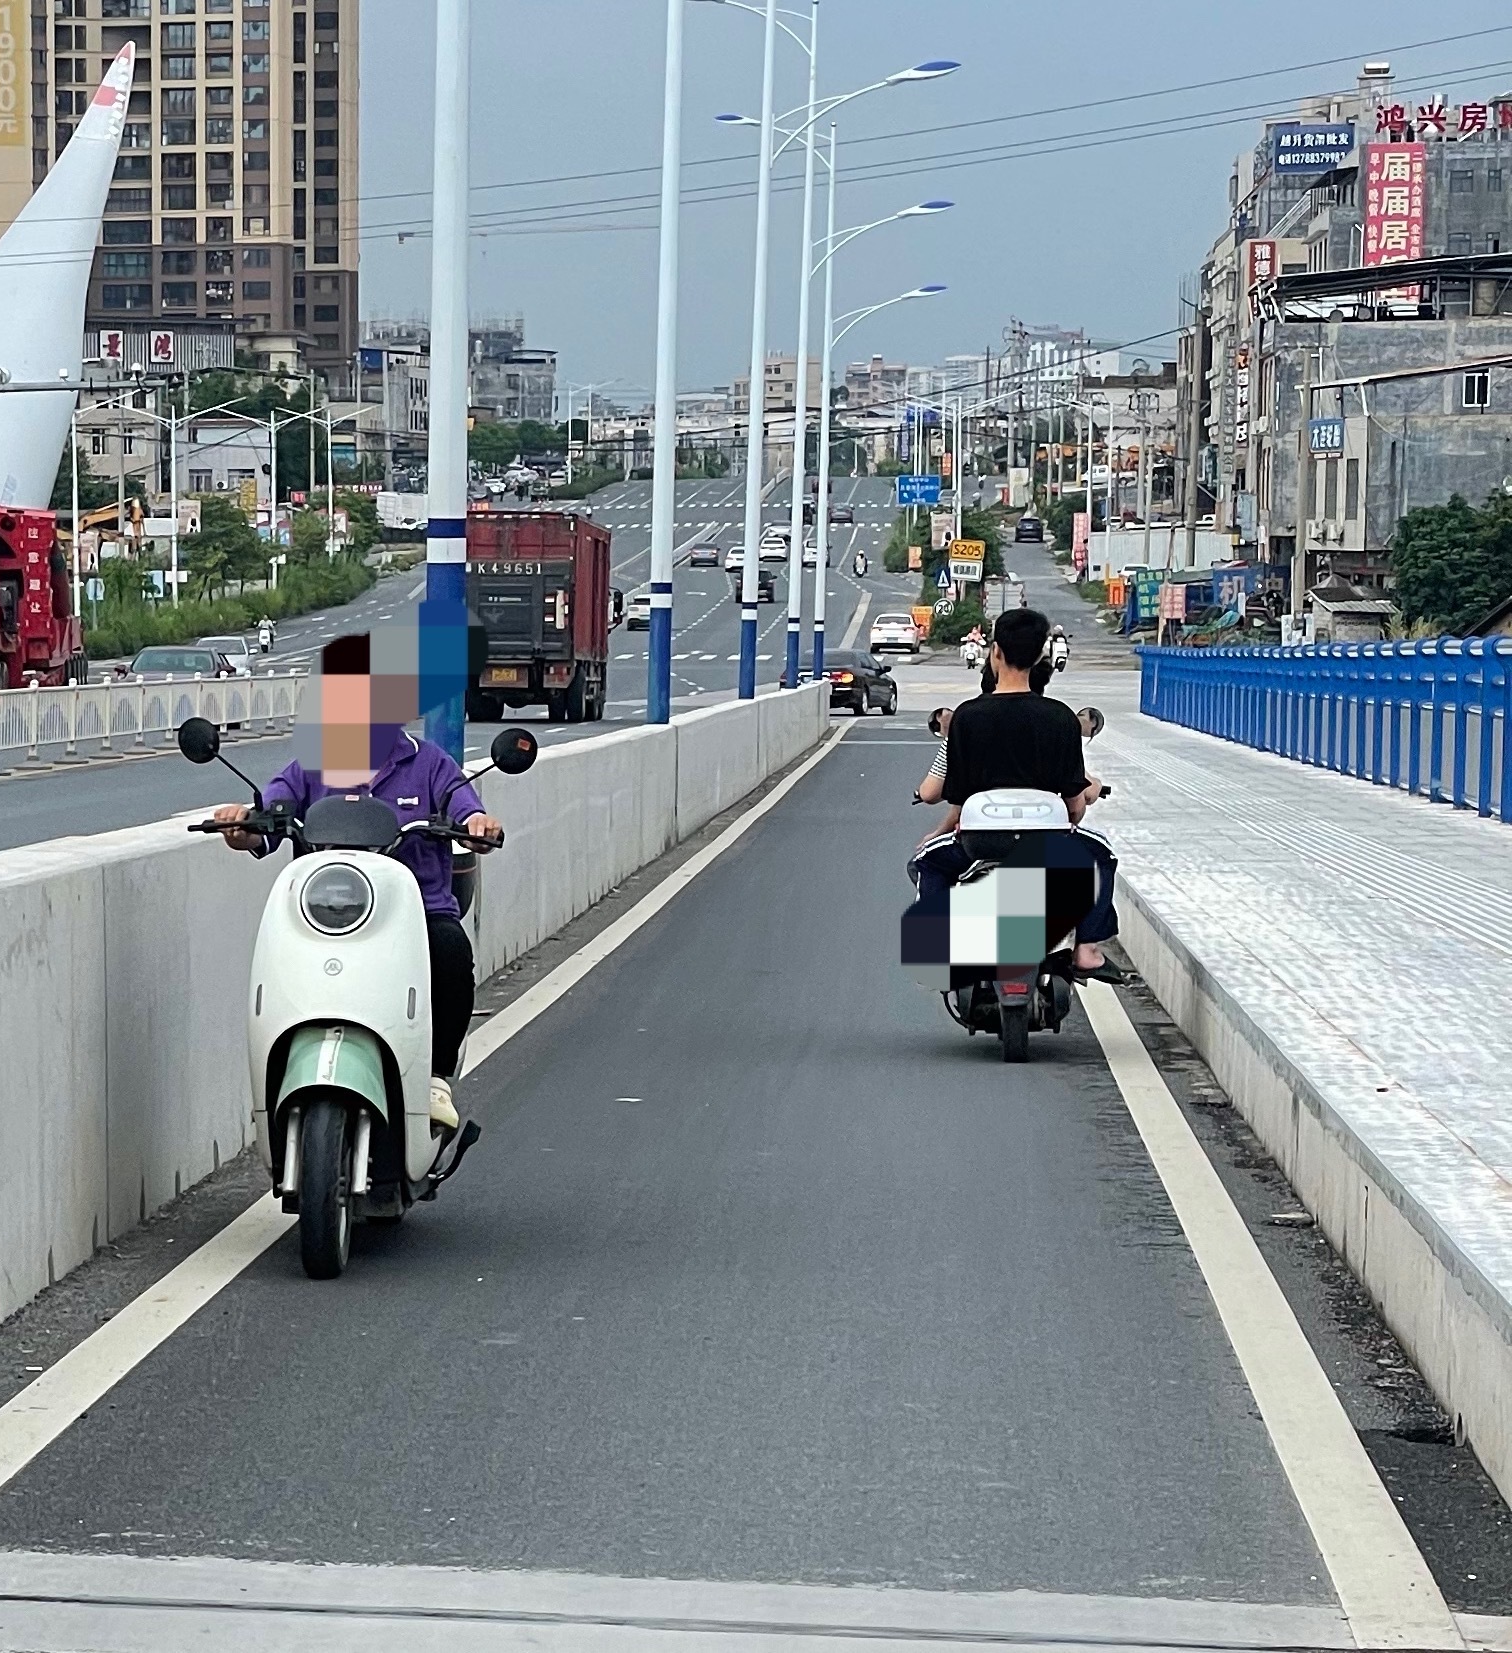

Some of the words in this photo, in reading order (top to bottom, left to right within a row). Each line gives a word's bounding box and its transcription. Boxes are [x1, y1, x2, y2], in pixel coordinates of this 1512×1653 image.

[1378, 153, 1411, 298] 届届居
[1254, 244, 1271, 281] 雅德
[953, 543, 981, 557] S205
[937, 603, 950, 614] 20
